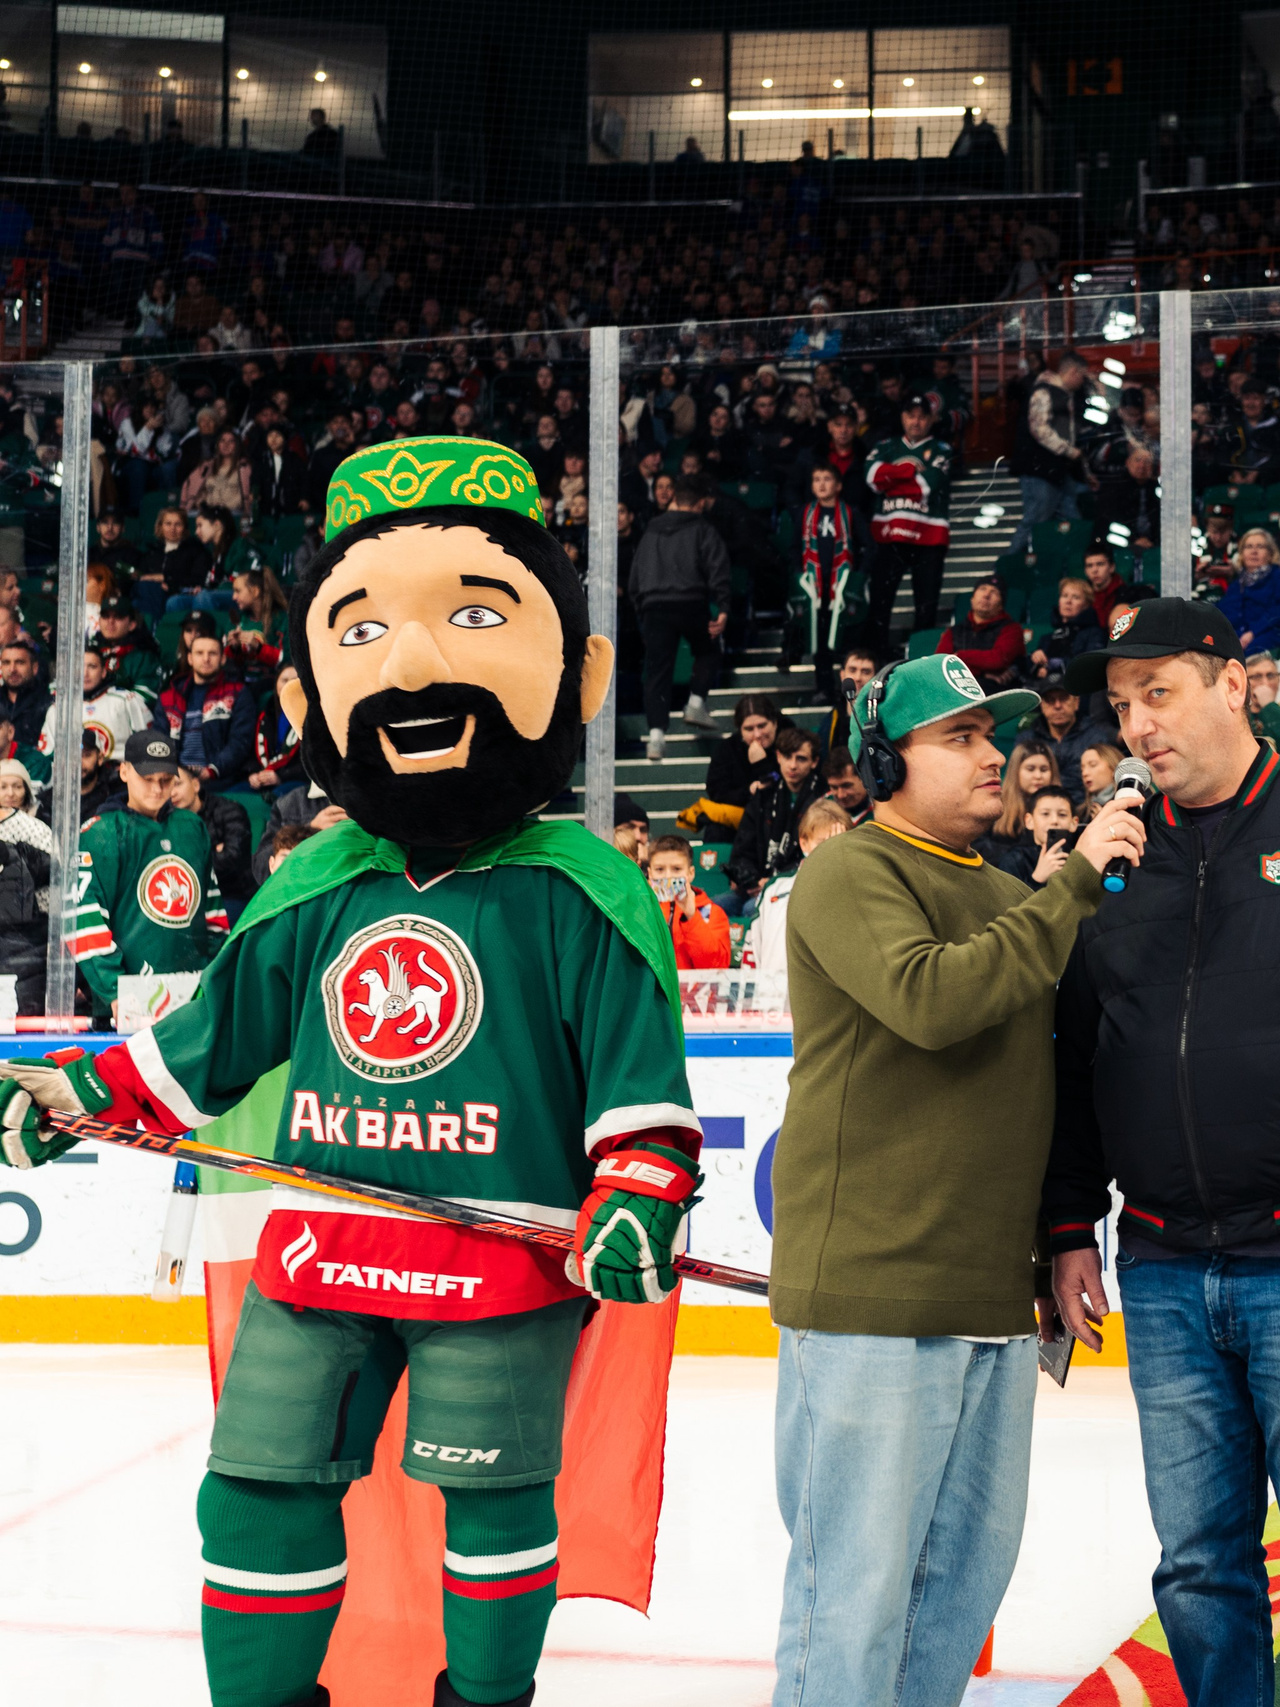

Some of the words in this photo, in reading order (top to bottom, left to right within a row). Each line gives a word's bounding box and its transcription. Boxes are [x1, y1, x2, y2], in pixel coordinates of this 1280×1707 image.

[346, 1052, 437, 1077] ТАТАРСТАН
[333, 1092, 447, 1111] KAZAN
[355, 1101, 499, 1155] BARS
[594, 1158, 677, 1189] UE
[316, 1261, 483, 1299] TATNEFT
[412, 1439, 502, 1464] CCM
